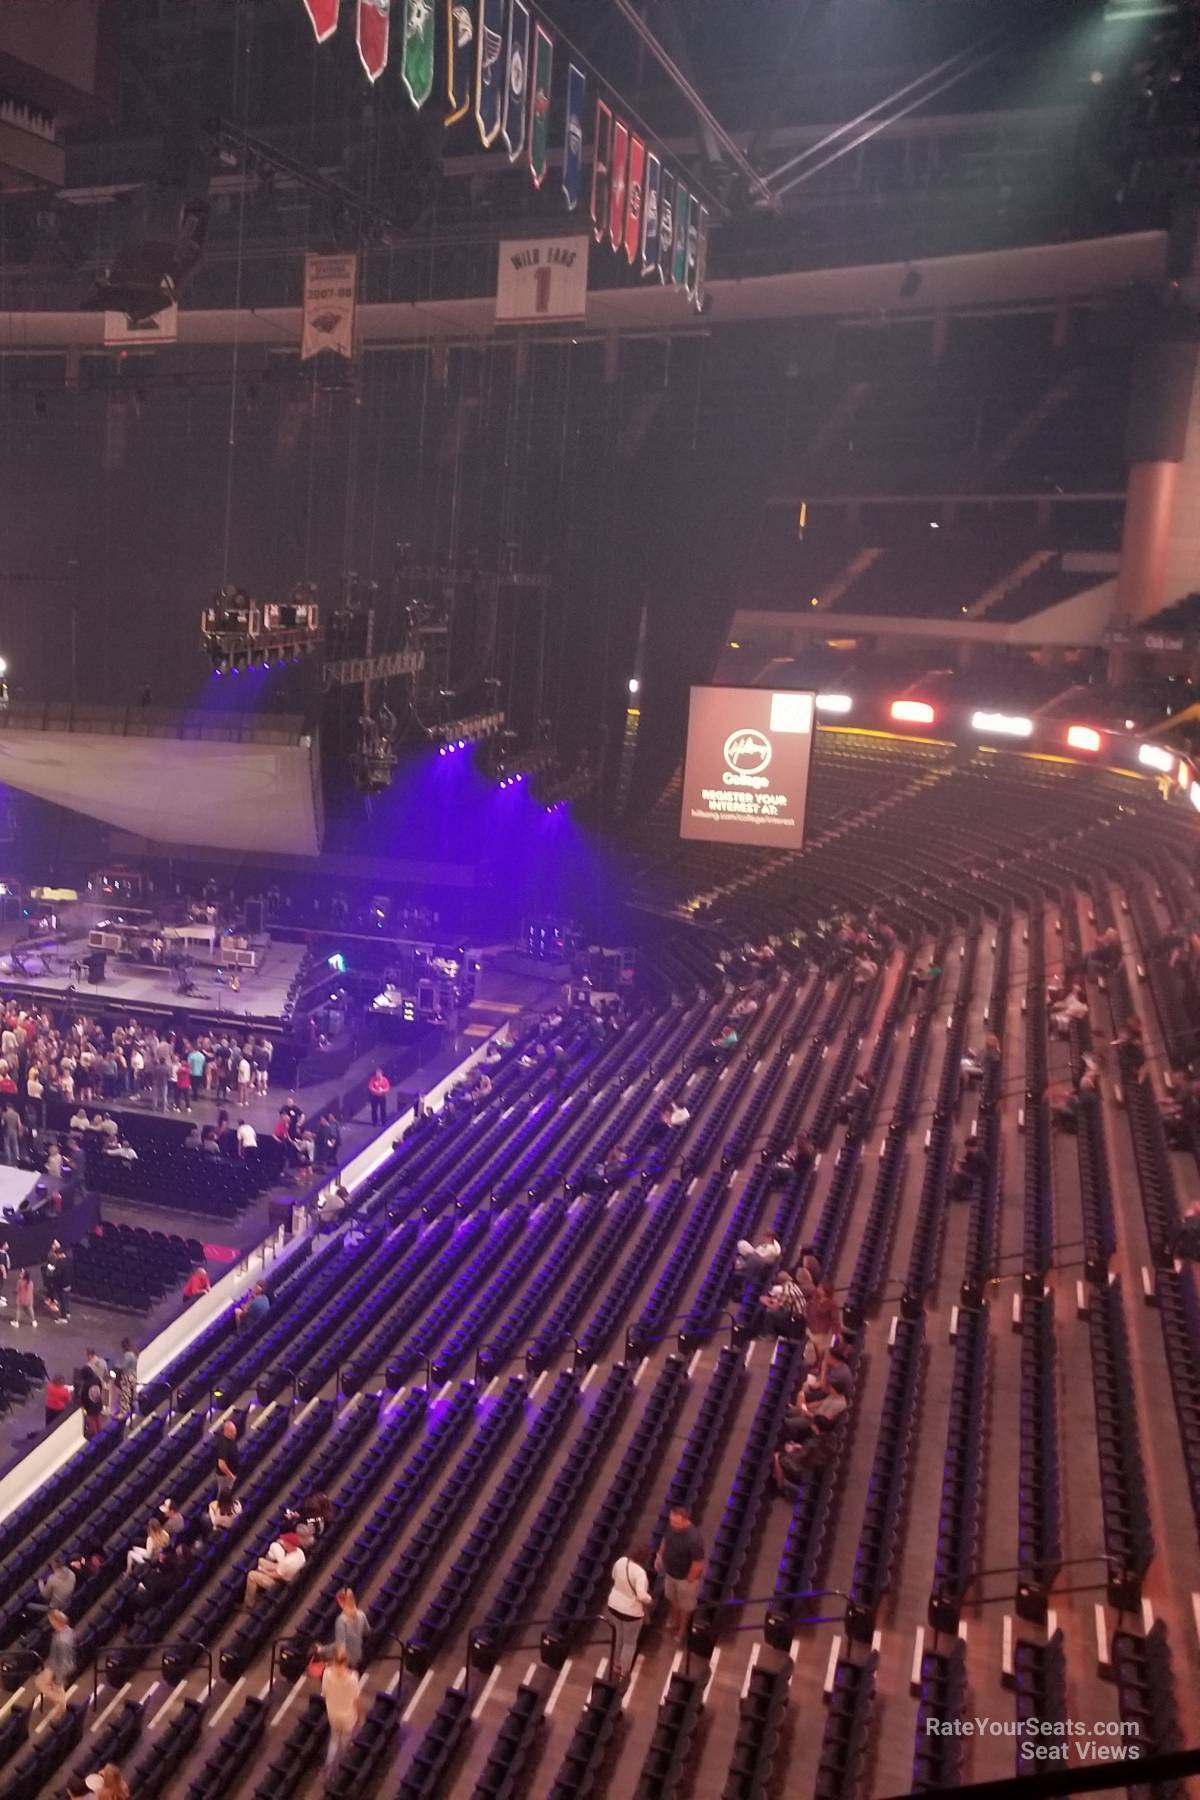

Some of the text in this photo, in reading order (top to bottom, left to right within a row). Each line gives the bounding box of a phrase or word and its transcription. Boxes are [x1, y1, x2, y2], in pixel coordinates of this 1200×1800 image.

[510, 247, 577, 271] WILD FANS
[533, 266, 551, 314] 1
[701, 789, 788, 807] REGISTER YOUR
[709, 800, 760, 814] INTEREST
